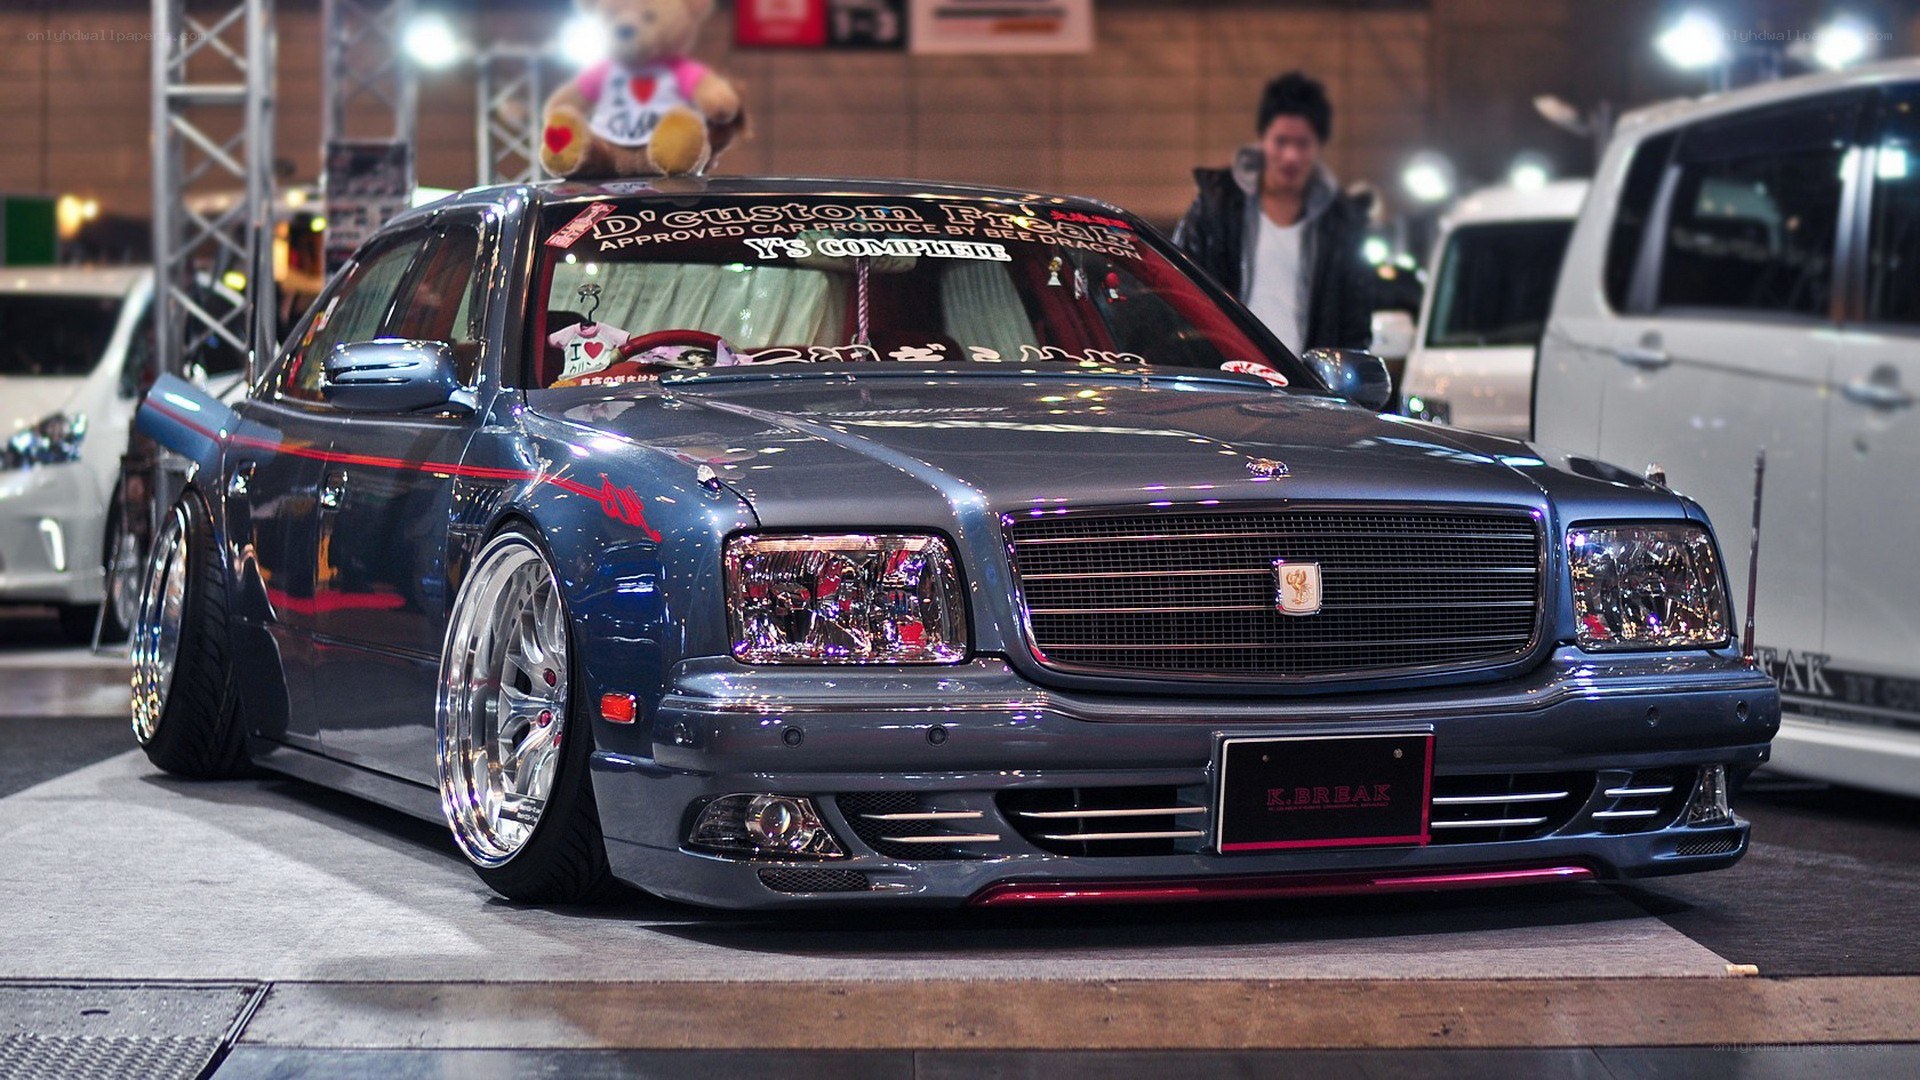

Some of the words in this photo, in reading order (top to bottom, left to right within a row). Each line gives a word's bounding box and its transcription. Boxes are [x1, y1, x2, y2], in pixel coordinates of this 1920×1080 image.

[593, 203, 924, 240] D'custom
[600, 225, 745, 251] APPROVED
[751, 222, 808, 235] CAR
[813, 222, 942, 235] PRODUCE
[944, 225, 976, 237] BY
[984, 228, 1036, 243] BEE
[1039, 234, 1143, 261] DRAGON
[816, 238, 1013, 262] COMPLETE
[570, 342, 582, 362] I
[1267, 784, 1391, 806] K.BREAK
